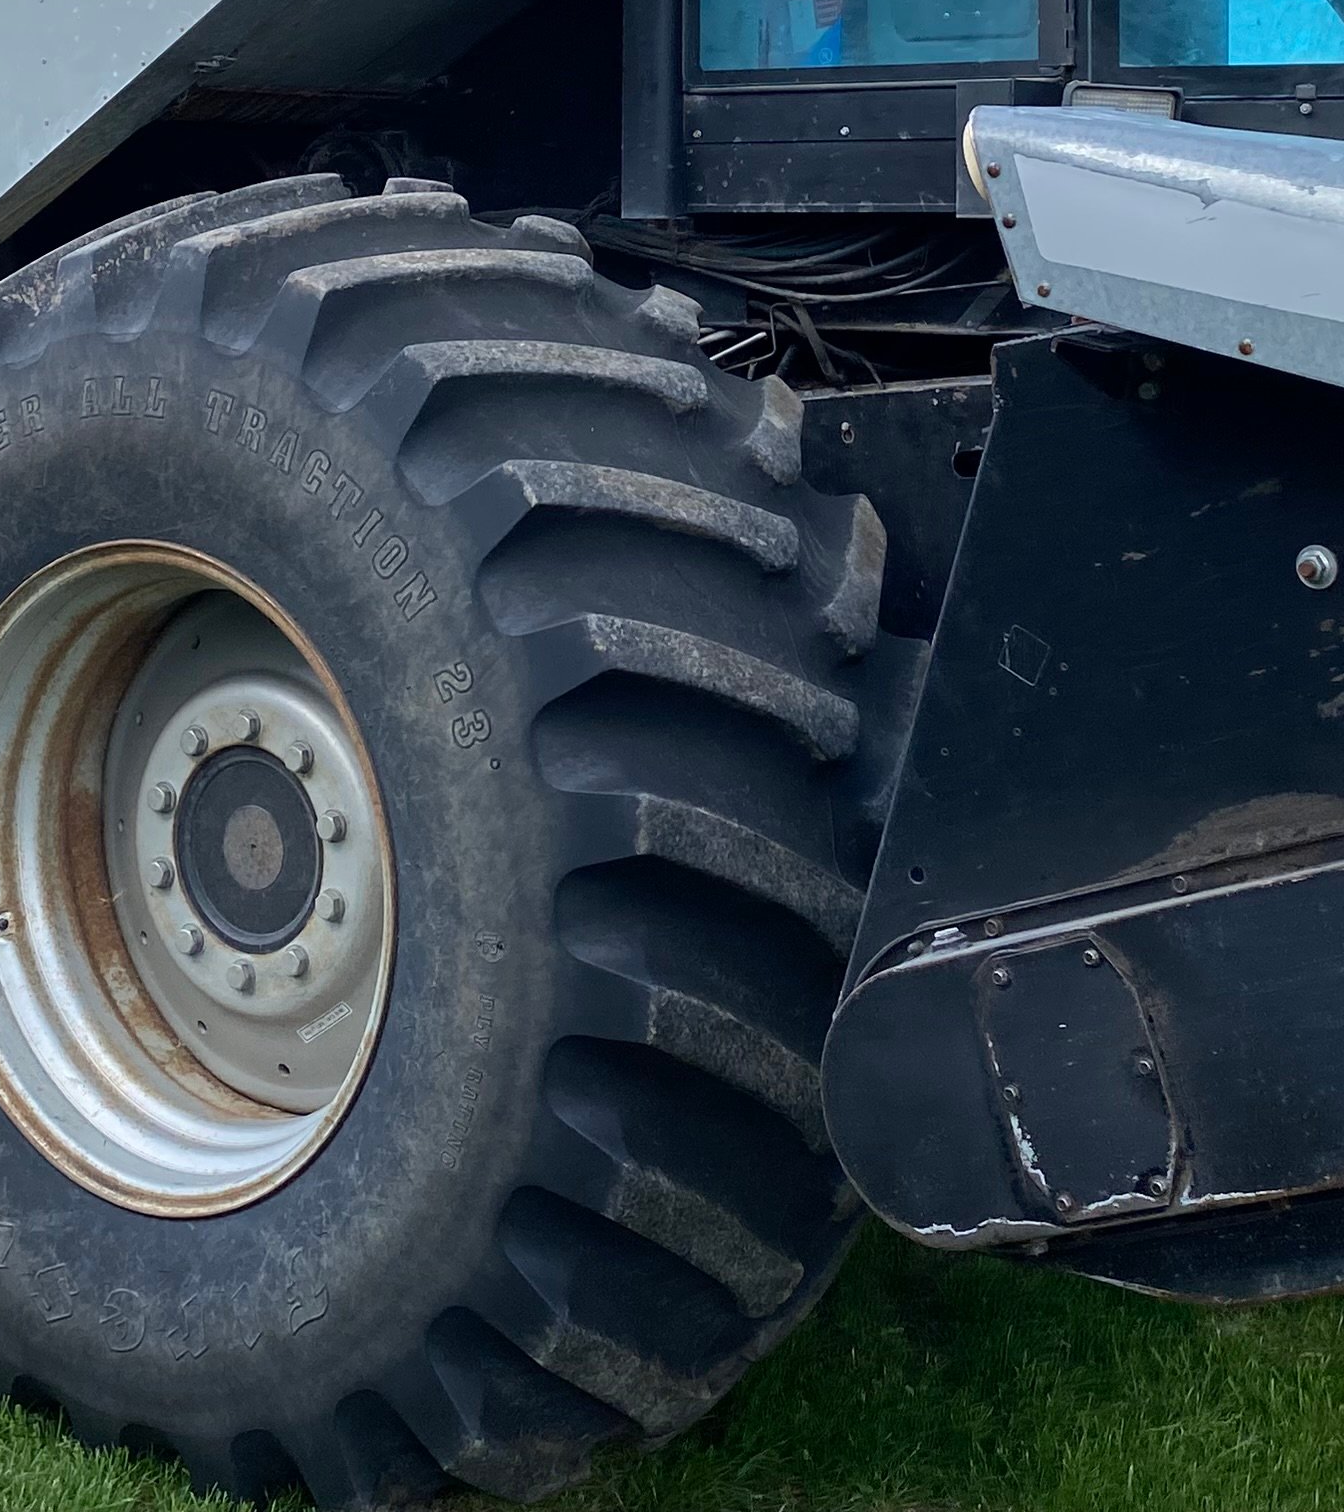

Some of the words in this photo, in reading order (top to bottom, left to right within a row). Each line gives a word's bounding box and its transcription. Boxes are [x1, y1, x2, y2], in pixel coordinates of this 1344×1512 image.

[80, 375, 167, 420] ALL
[205, 390, 438, 622] TRACTION
[473, 994, 496, 1051] PLY
[440, 1066, 484, 1170] RATING
